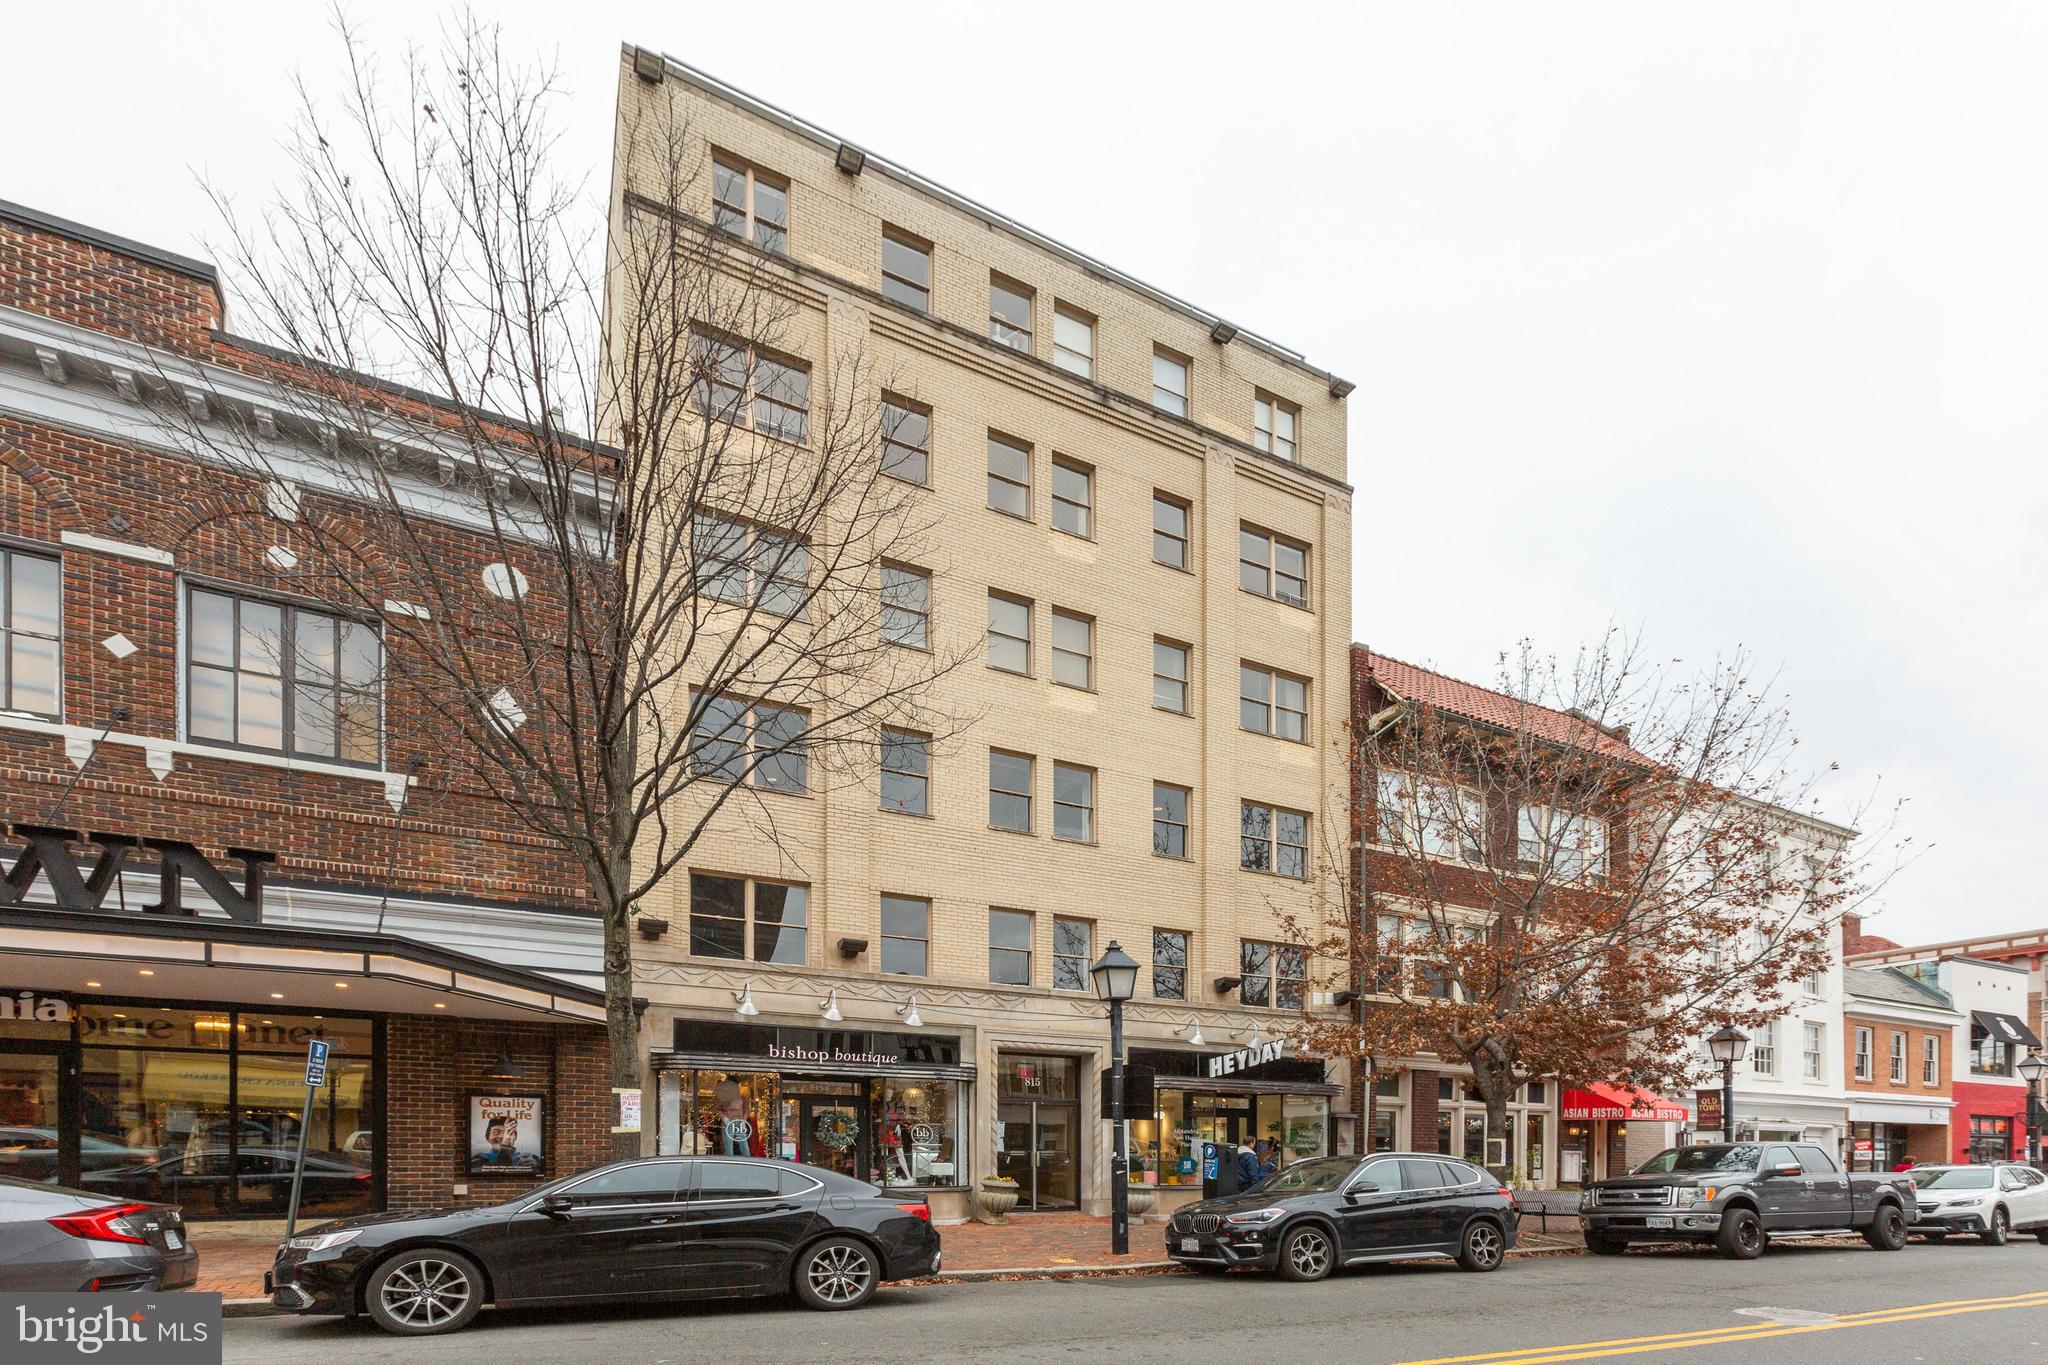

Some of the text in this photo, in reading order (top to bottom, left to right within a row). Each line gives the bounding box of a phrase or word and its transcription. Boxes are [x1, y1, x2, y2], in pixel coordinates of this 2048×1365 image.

[316, 1045, 323, 1057] P
[768, 1044, 898, 1067] bishop boutique
[1209, 1038, 1285, 1078] HEYDAY
[1024, 1077, 1041, 1087] 815
[479, 1098, 535, 1110] Quality
[1701, 1097, 1718, 1105] OLD
[482, 1109, 533, 1120] for Life
[1563, 1107, 1624, 1118] ASIAN BISTRO
[1631, 1108, 1683, 1120] ASIAN BISTRO
[732, 1123, 748, 1134] bb
[916, 1127, 930, 1137] bb
